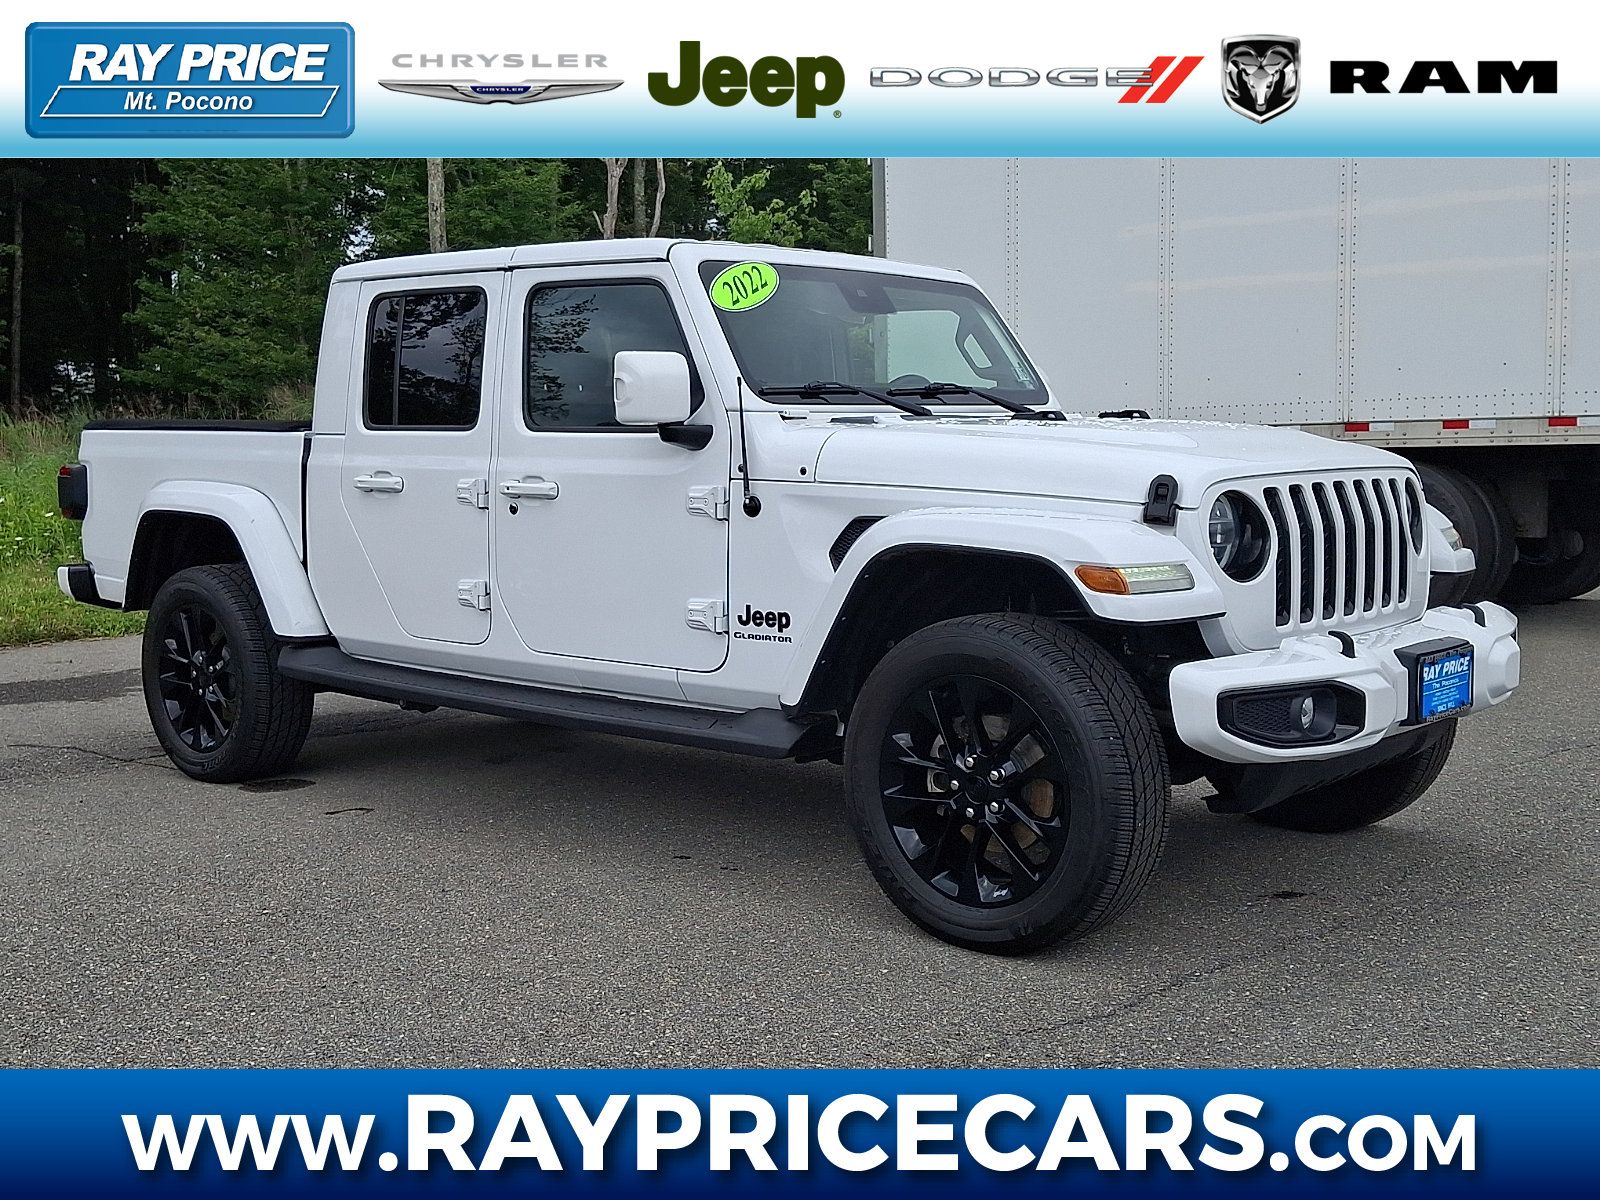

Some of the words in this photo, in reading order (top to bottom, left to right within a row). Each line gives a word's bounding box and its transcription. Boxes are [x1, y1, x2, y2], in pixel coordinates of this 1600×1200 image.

[722, 265, 769, 307] 2022
[737, 604, 791, 633] Jeep
[733, 631, 793, 643] GLADIATOR
[1423, 664, 1441, 681] RAY
[1442, 656, 1470, 677] PRICE
